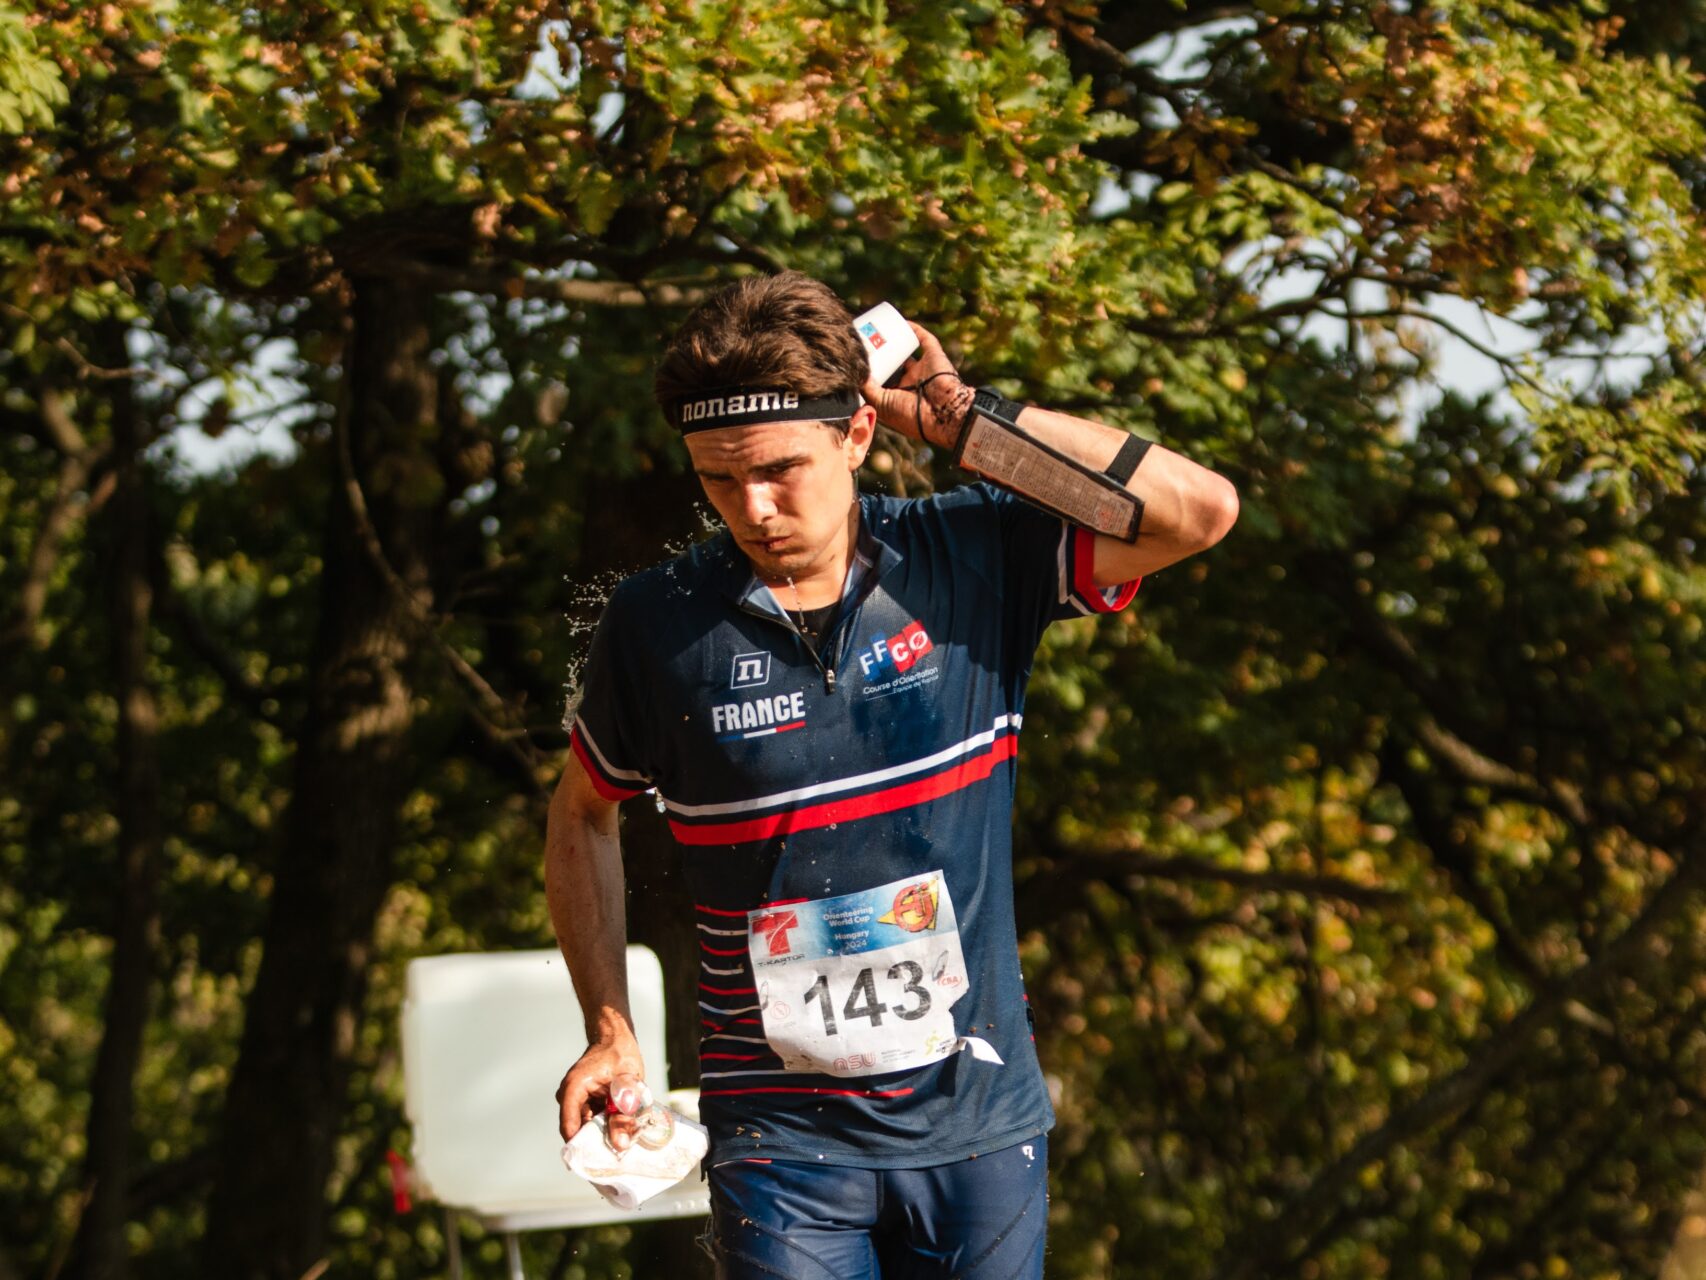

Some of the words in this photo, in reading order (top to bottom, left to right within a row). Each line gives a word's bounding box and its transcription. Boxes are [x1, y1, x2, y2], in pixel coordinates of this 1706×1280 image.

[682, 390, 799, 422] noname
[863, 682, 891, 695] Course
[712, 692, 806, 733] FRANCE
[823, 906, 874, 920] Orienteering
[829, 917, 853, 927] World
[854, 915, 871, 924] Cup
[834, 930, 870, 940] Hungary
[804, 960, 932, 1036] 143
